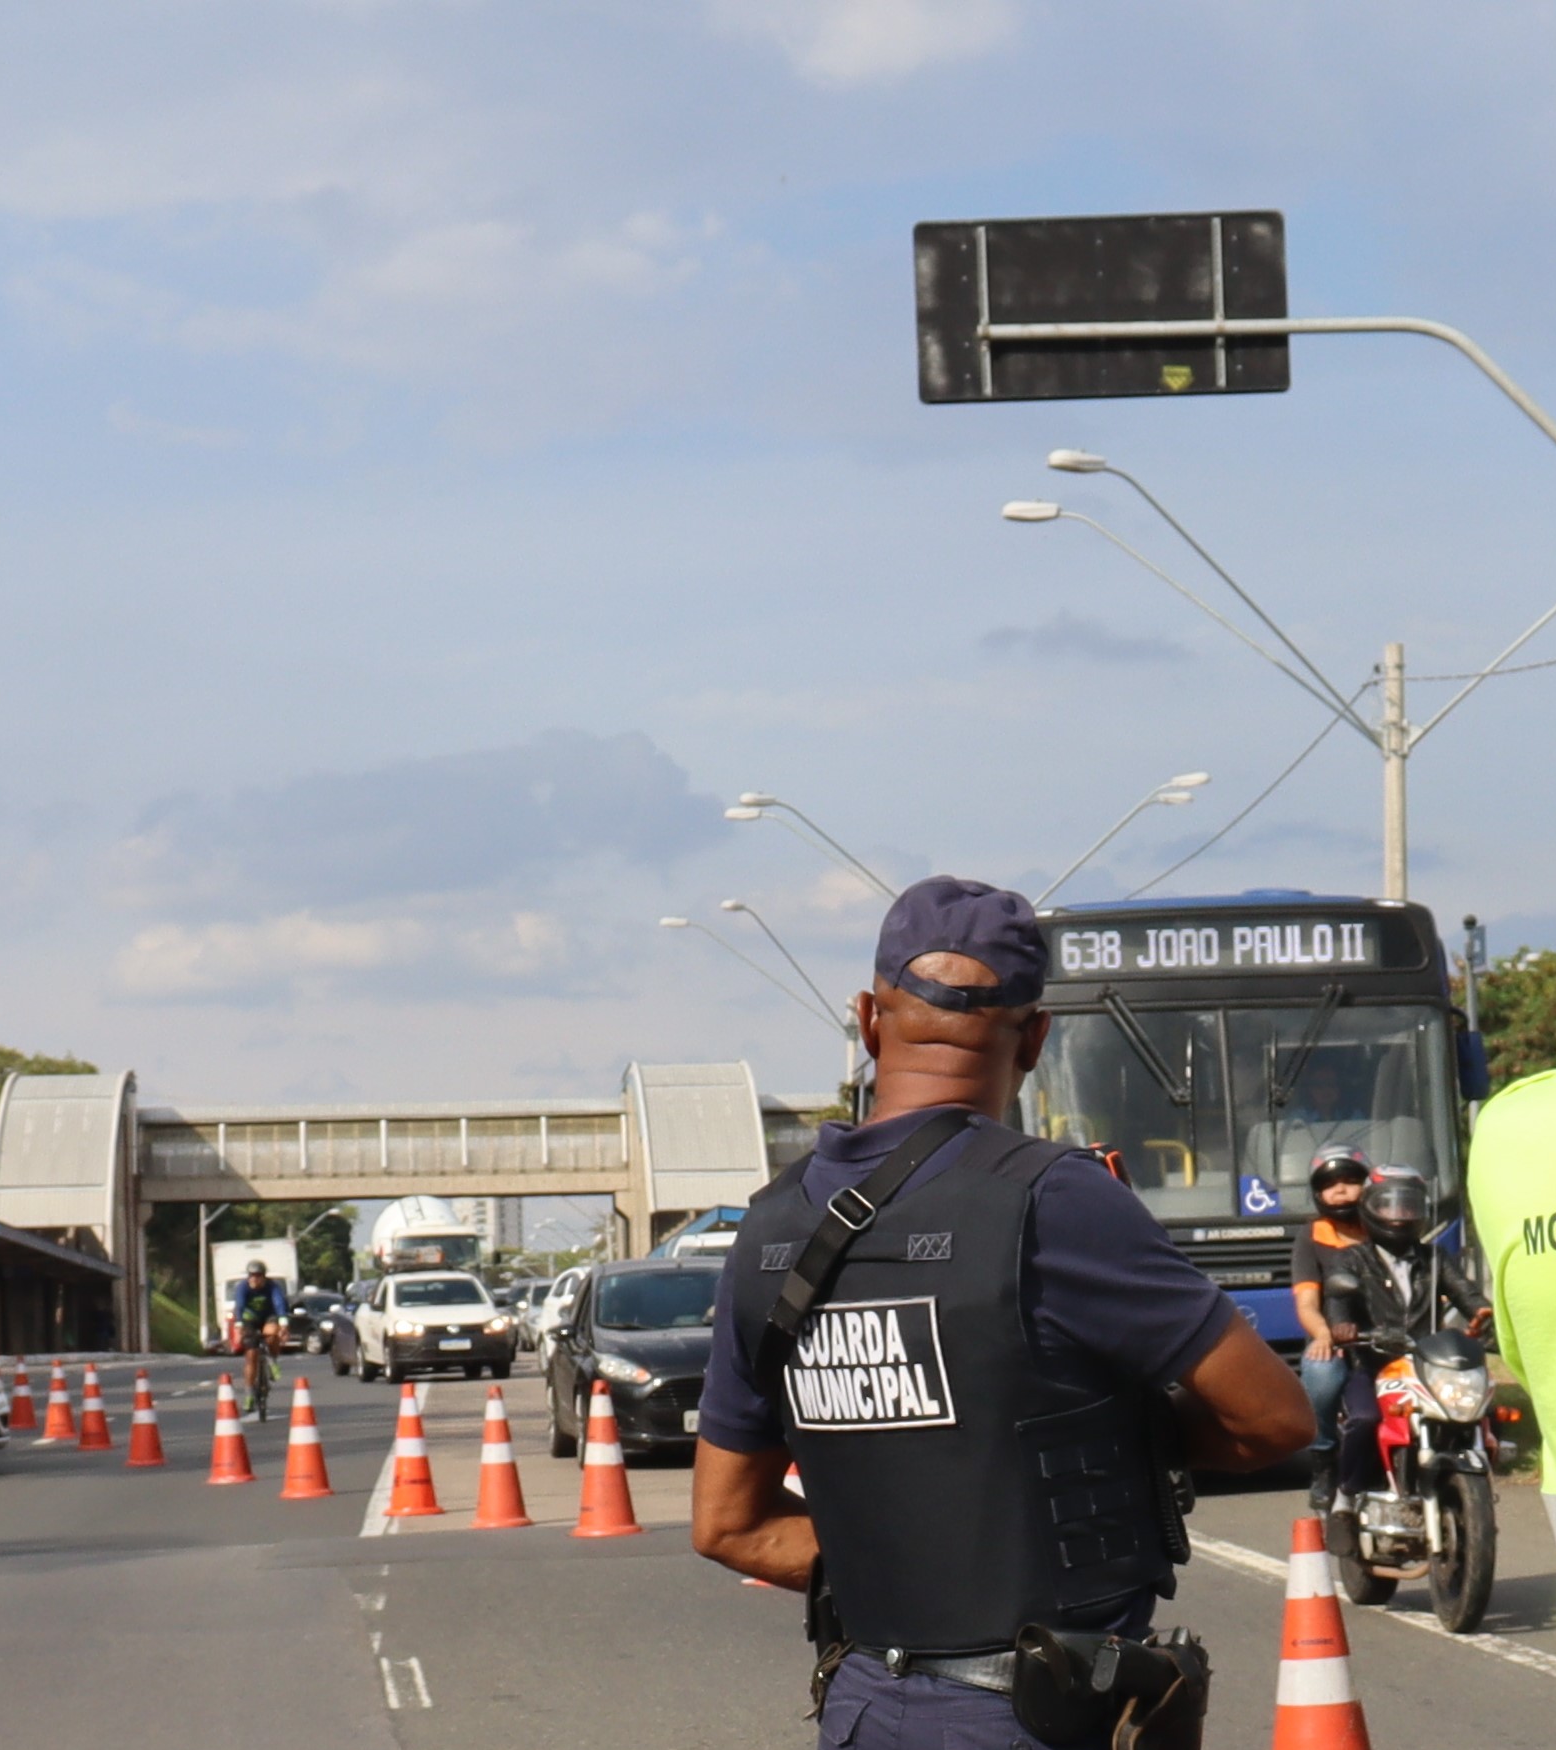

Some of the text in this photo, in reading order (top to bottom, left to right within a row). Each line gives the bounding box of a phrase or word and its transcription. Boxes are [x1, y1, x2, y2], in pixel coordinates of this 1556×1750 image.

[1060, 930, 1122, 970] 638
[1232, 924, 1333, 964] PAULO
[797, 1309, 908, 1367] GUARDA
[794, 1364, 940, 1420] MUNICIPAL
